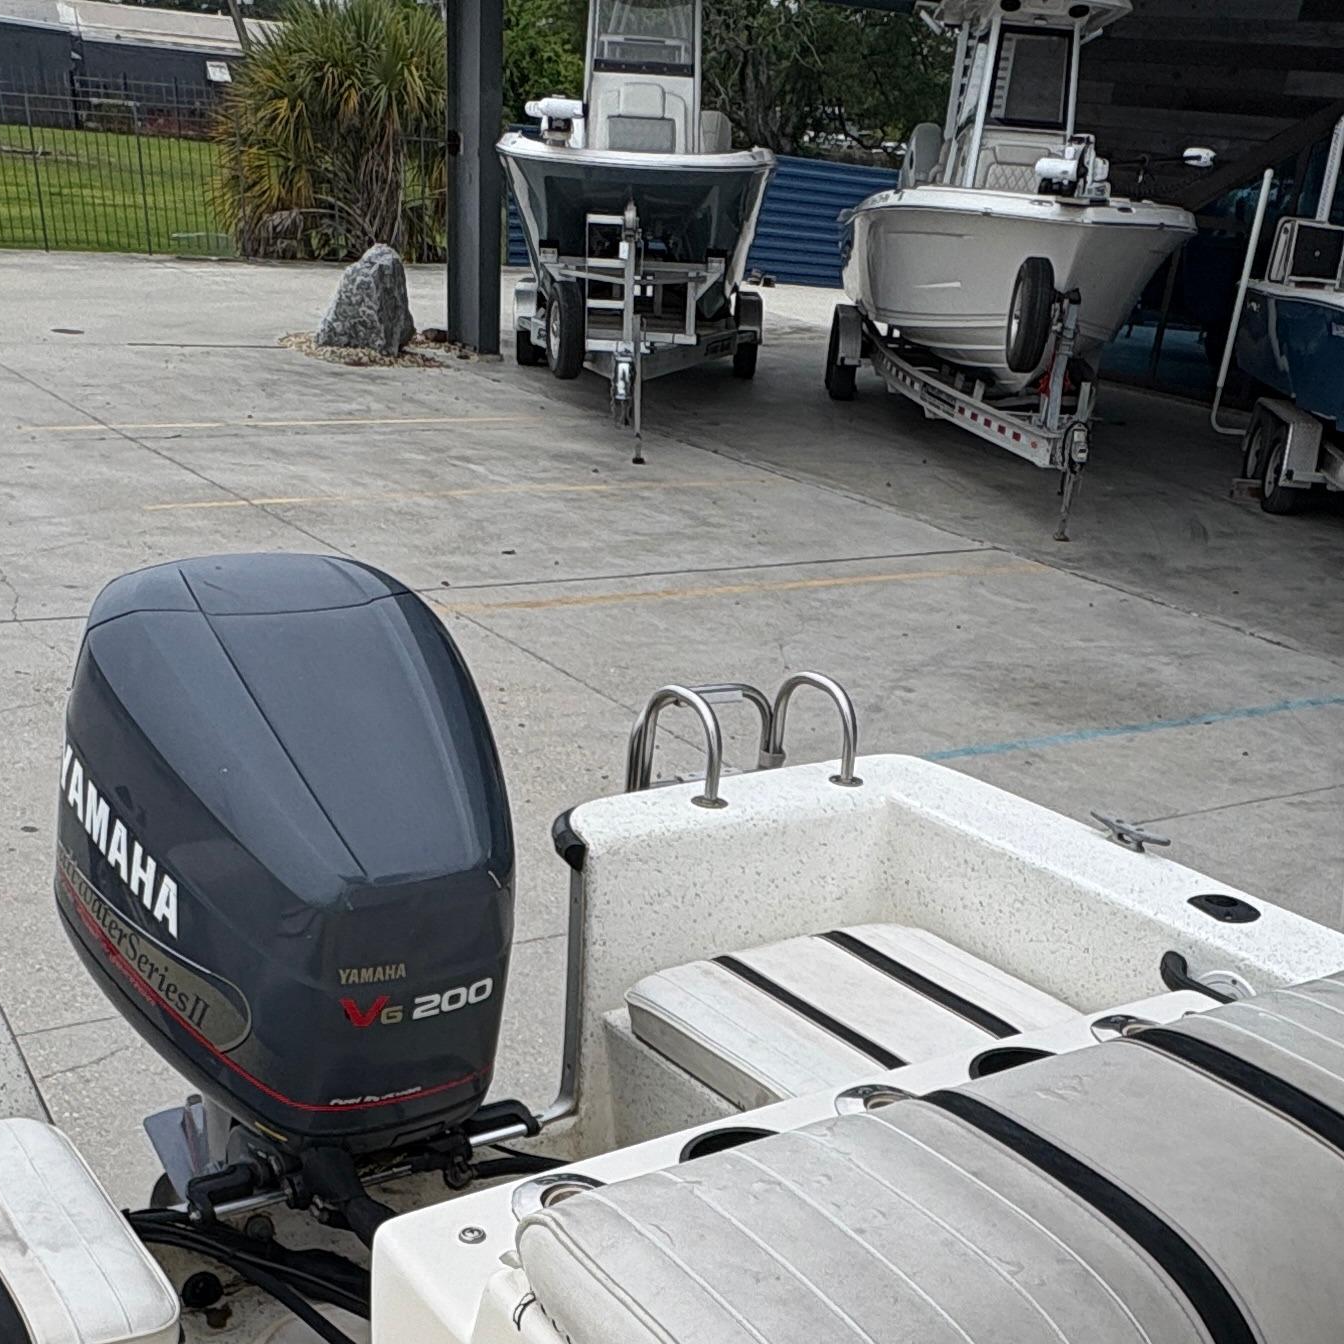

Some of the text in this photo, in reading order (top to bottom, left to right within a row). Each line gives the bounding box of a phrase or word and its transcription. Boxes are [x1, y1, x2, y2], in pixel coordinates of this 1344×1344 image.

[60, 744, 178, 940] YAMAHA
[338, 963, 407, 985] YAMAHA
[339, 977, 494, 1029] V6 200
